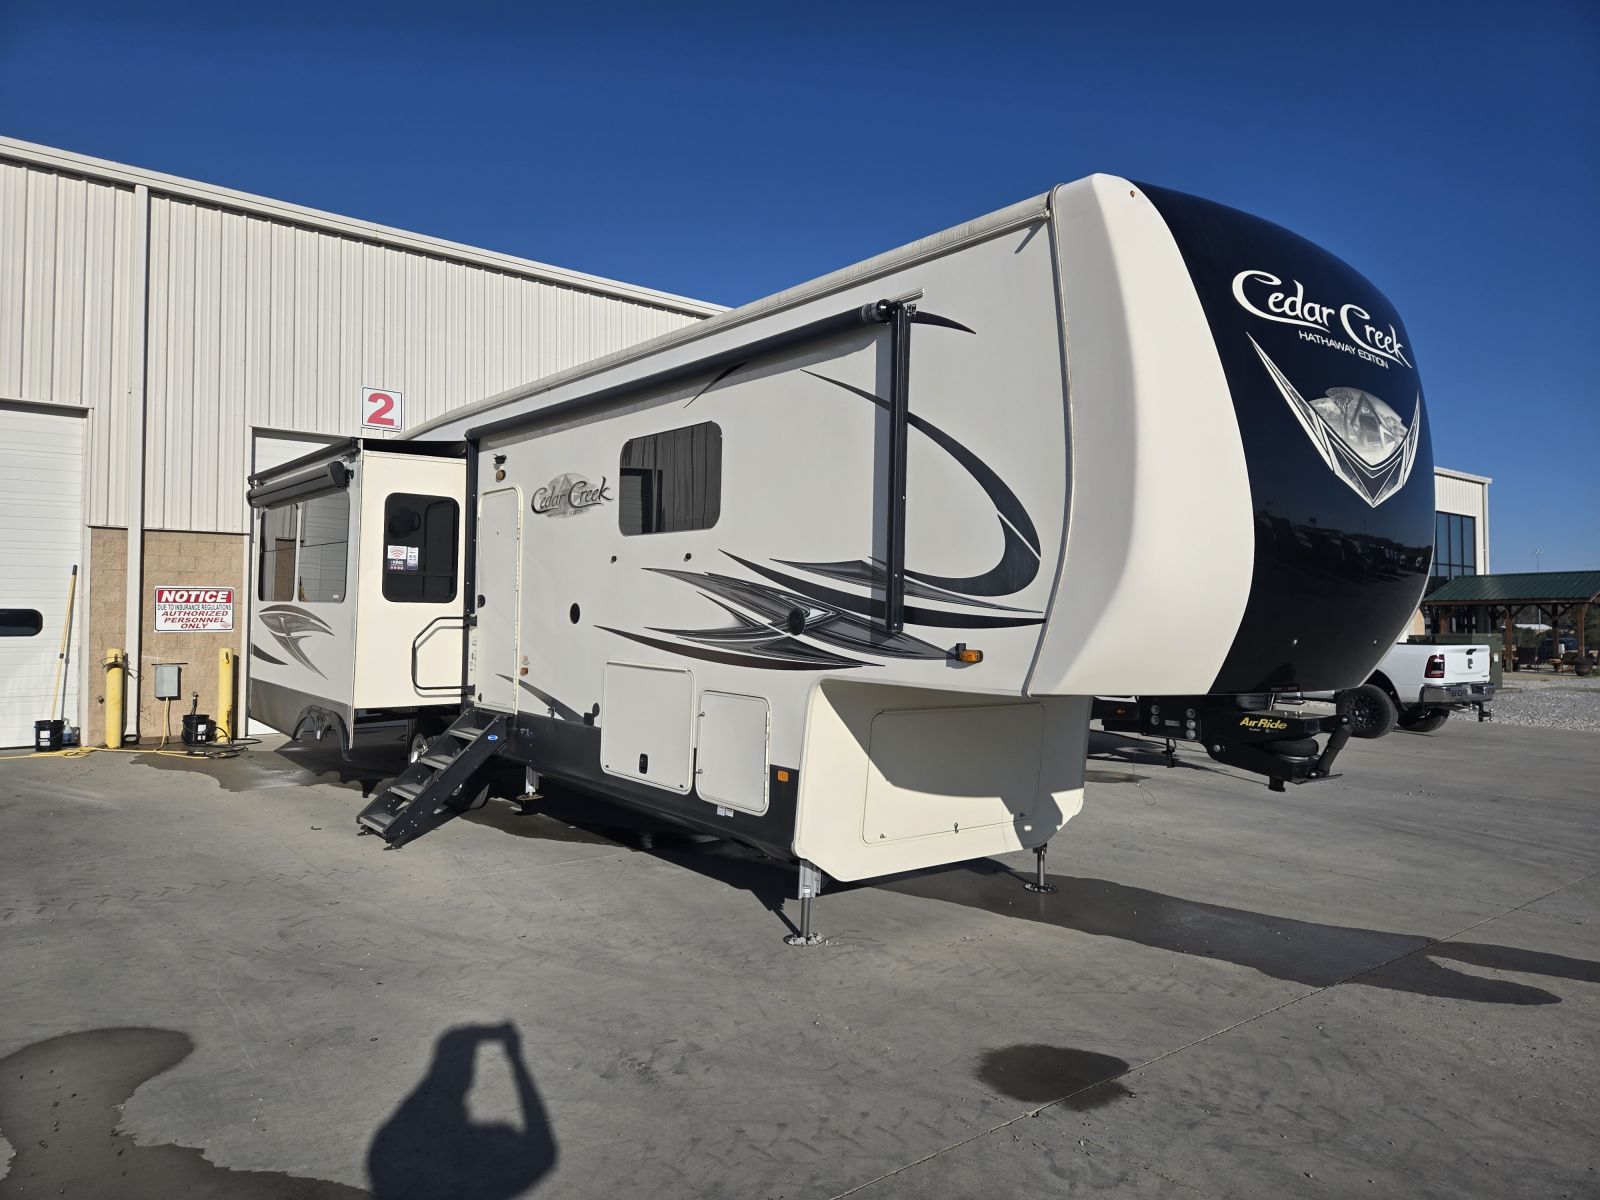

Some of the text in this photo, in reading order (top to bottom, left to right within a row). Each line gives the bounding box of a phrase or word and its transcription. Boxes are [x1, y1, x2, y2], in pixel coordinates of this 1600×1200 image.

[1232, 270, 1413, 369] Cedar Creek
[1298, 330, 1389, 369] HATHAWAY EDITION
[367, 392, 395, 426] 2
[531, 476, 614, 514] Cedar Creek
[161, 591, 228, 603] NOTICE
